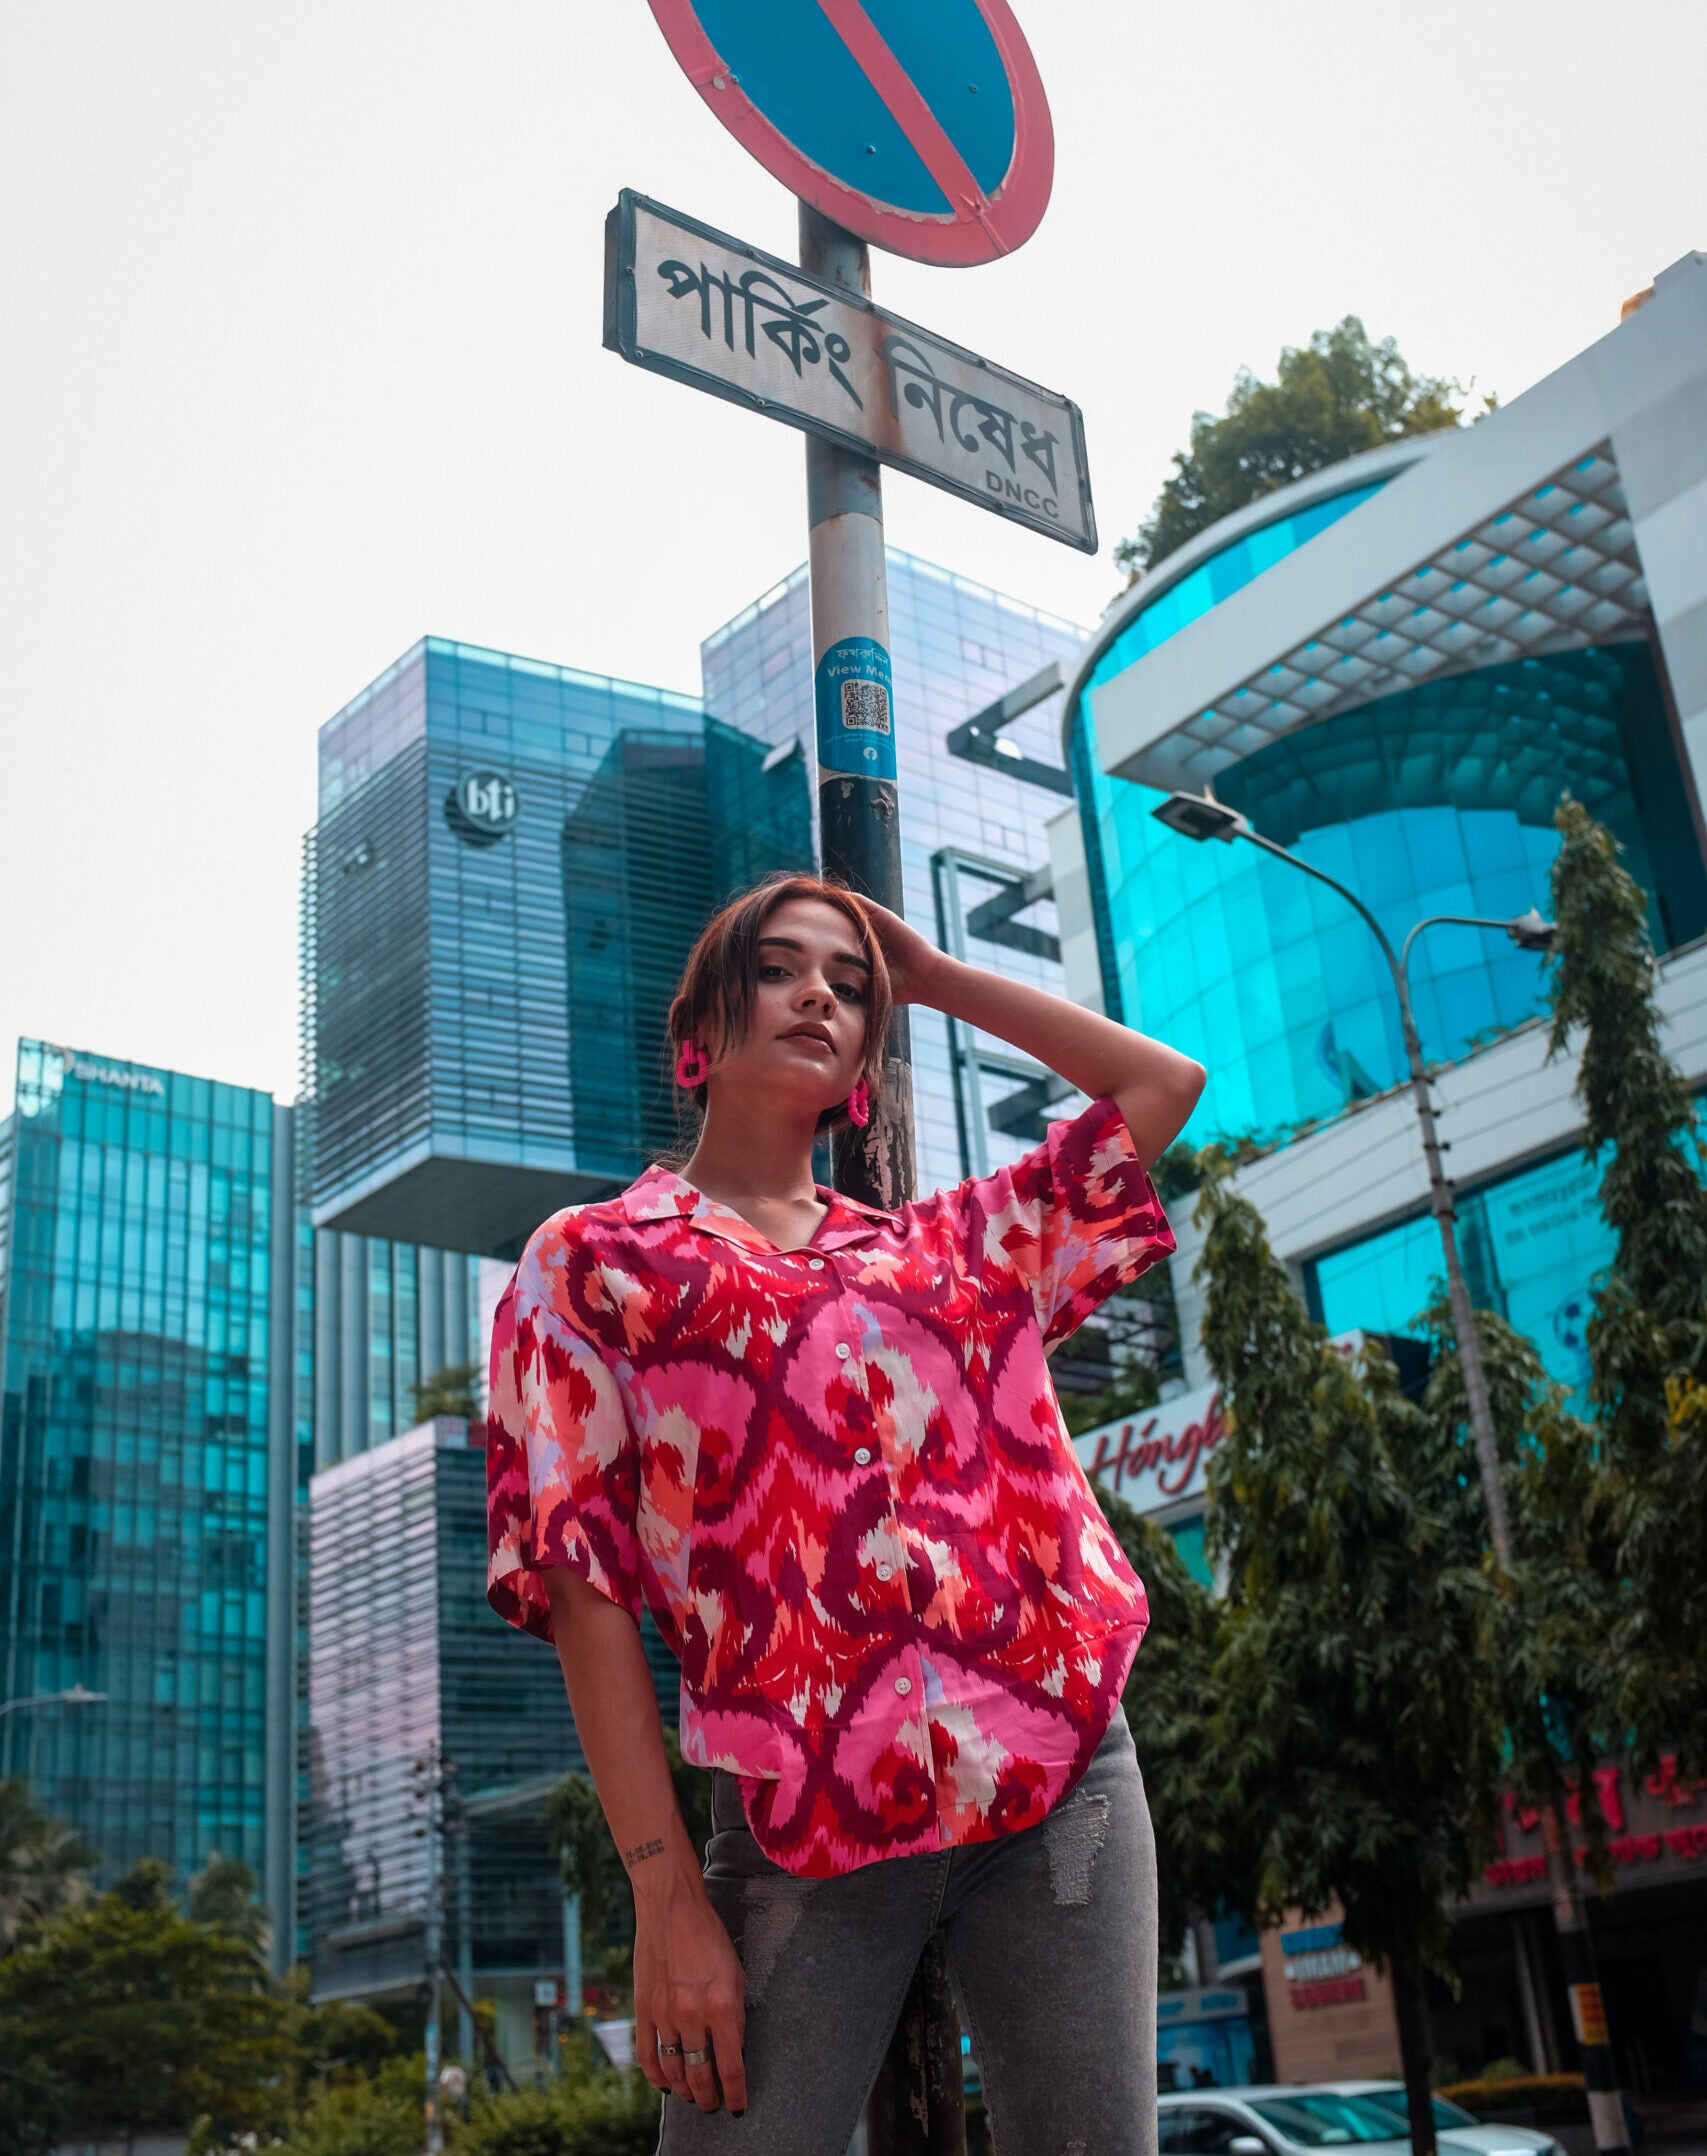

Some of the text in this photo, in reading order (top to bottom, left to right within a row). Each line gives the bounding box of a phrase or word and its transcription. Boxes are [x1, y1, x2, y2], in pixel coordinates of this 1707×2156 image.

[657, 260, 1060, 497] পার্কিং নিষেধ
[985, 469, 1060, 519] DNCC
[827, 664, 862, 678] View
[467, 778, 515, 822] bti
[75, 1061, 165, 1096] SHANTA
[1087, 1393, 1225, 1495] Hóngb
